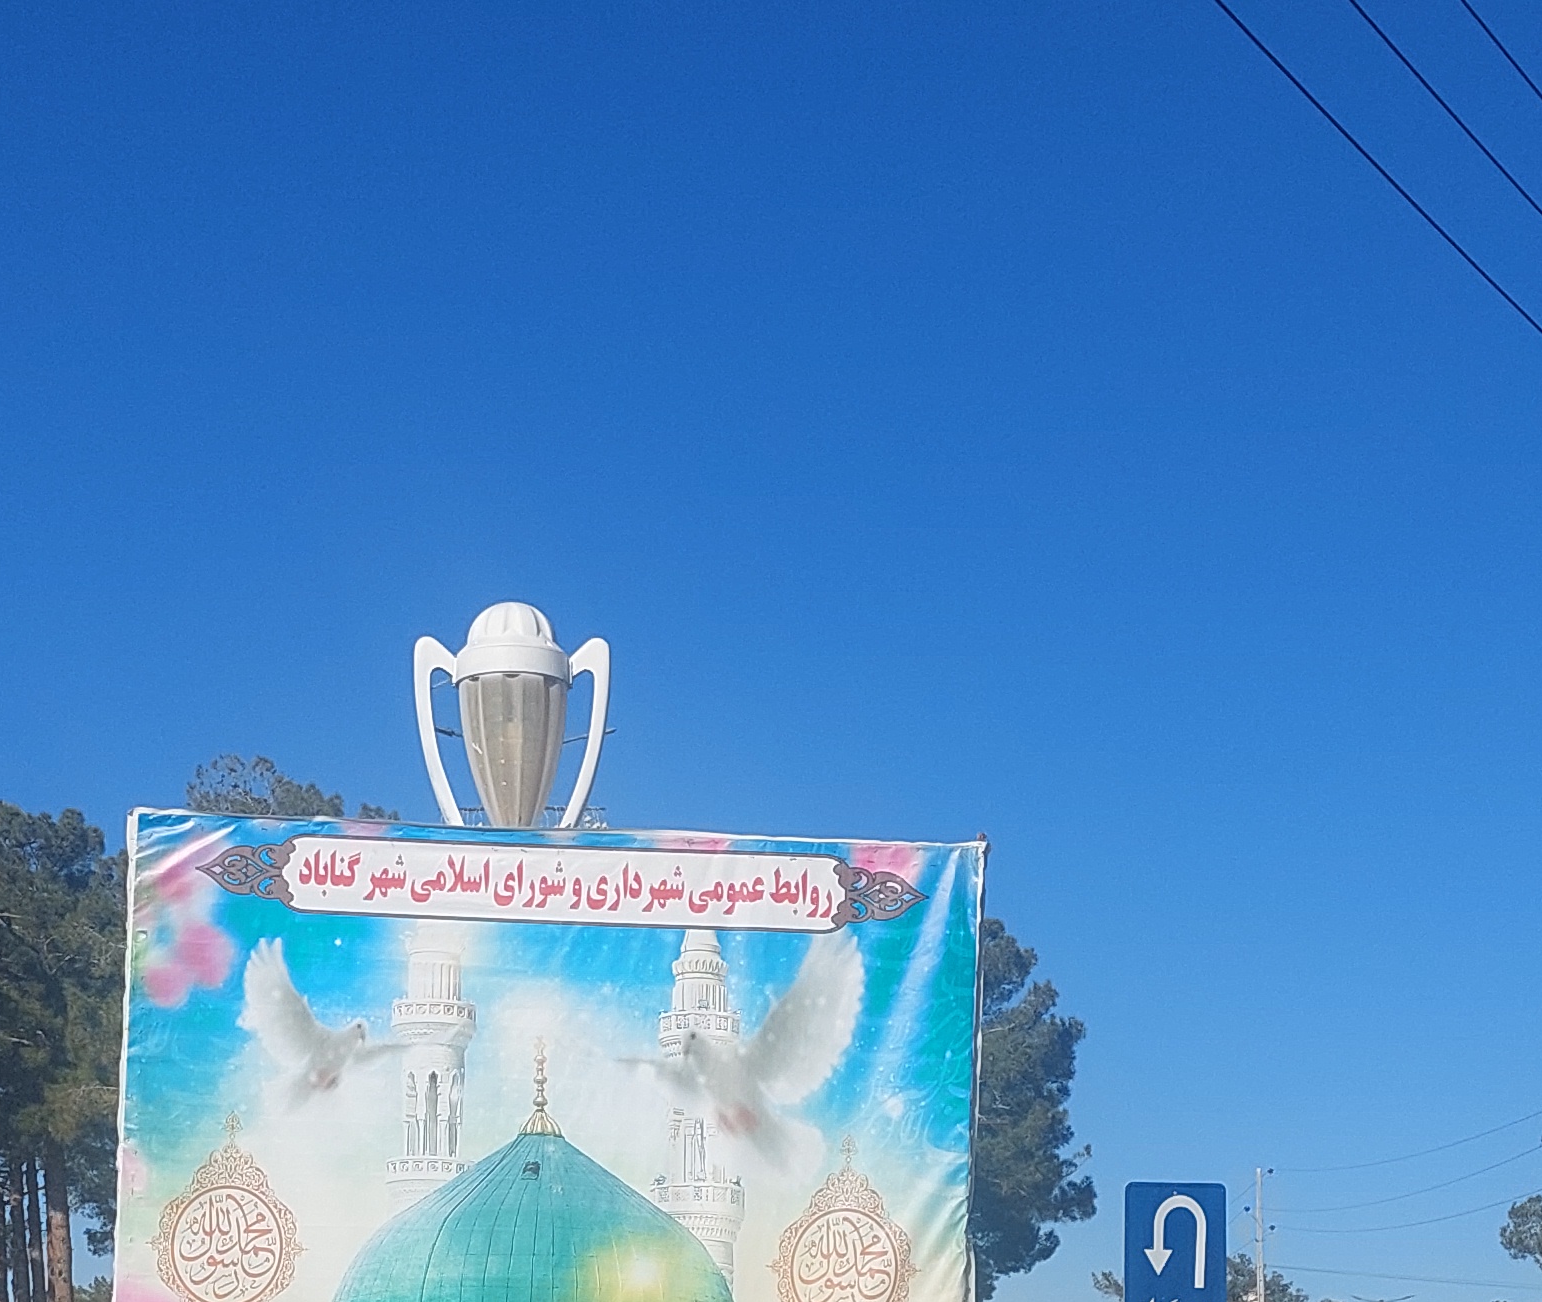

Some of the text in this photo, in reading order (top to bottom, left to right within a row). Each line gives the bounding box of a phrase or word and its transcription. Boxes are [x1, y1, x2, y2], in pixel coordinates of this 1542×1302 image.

[298, 849, 833, 918] روابط عمومی شهرداری و شورای اسلامی شهر گناباد
